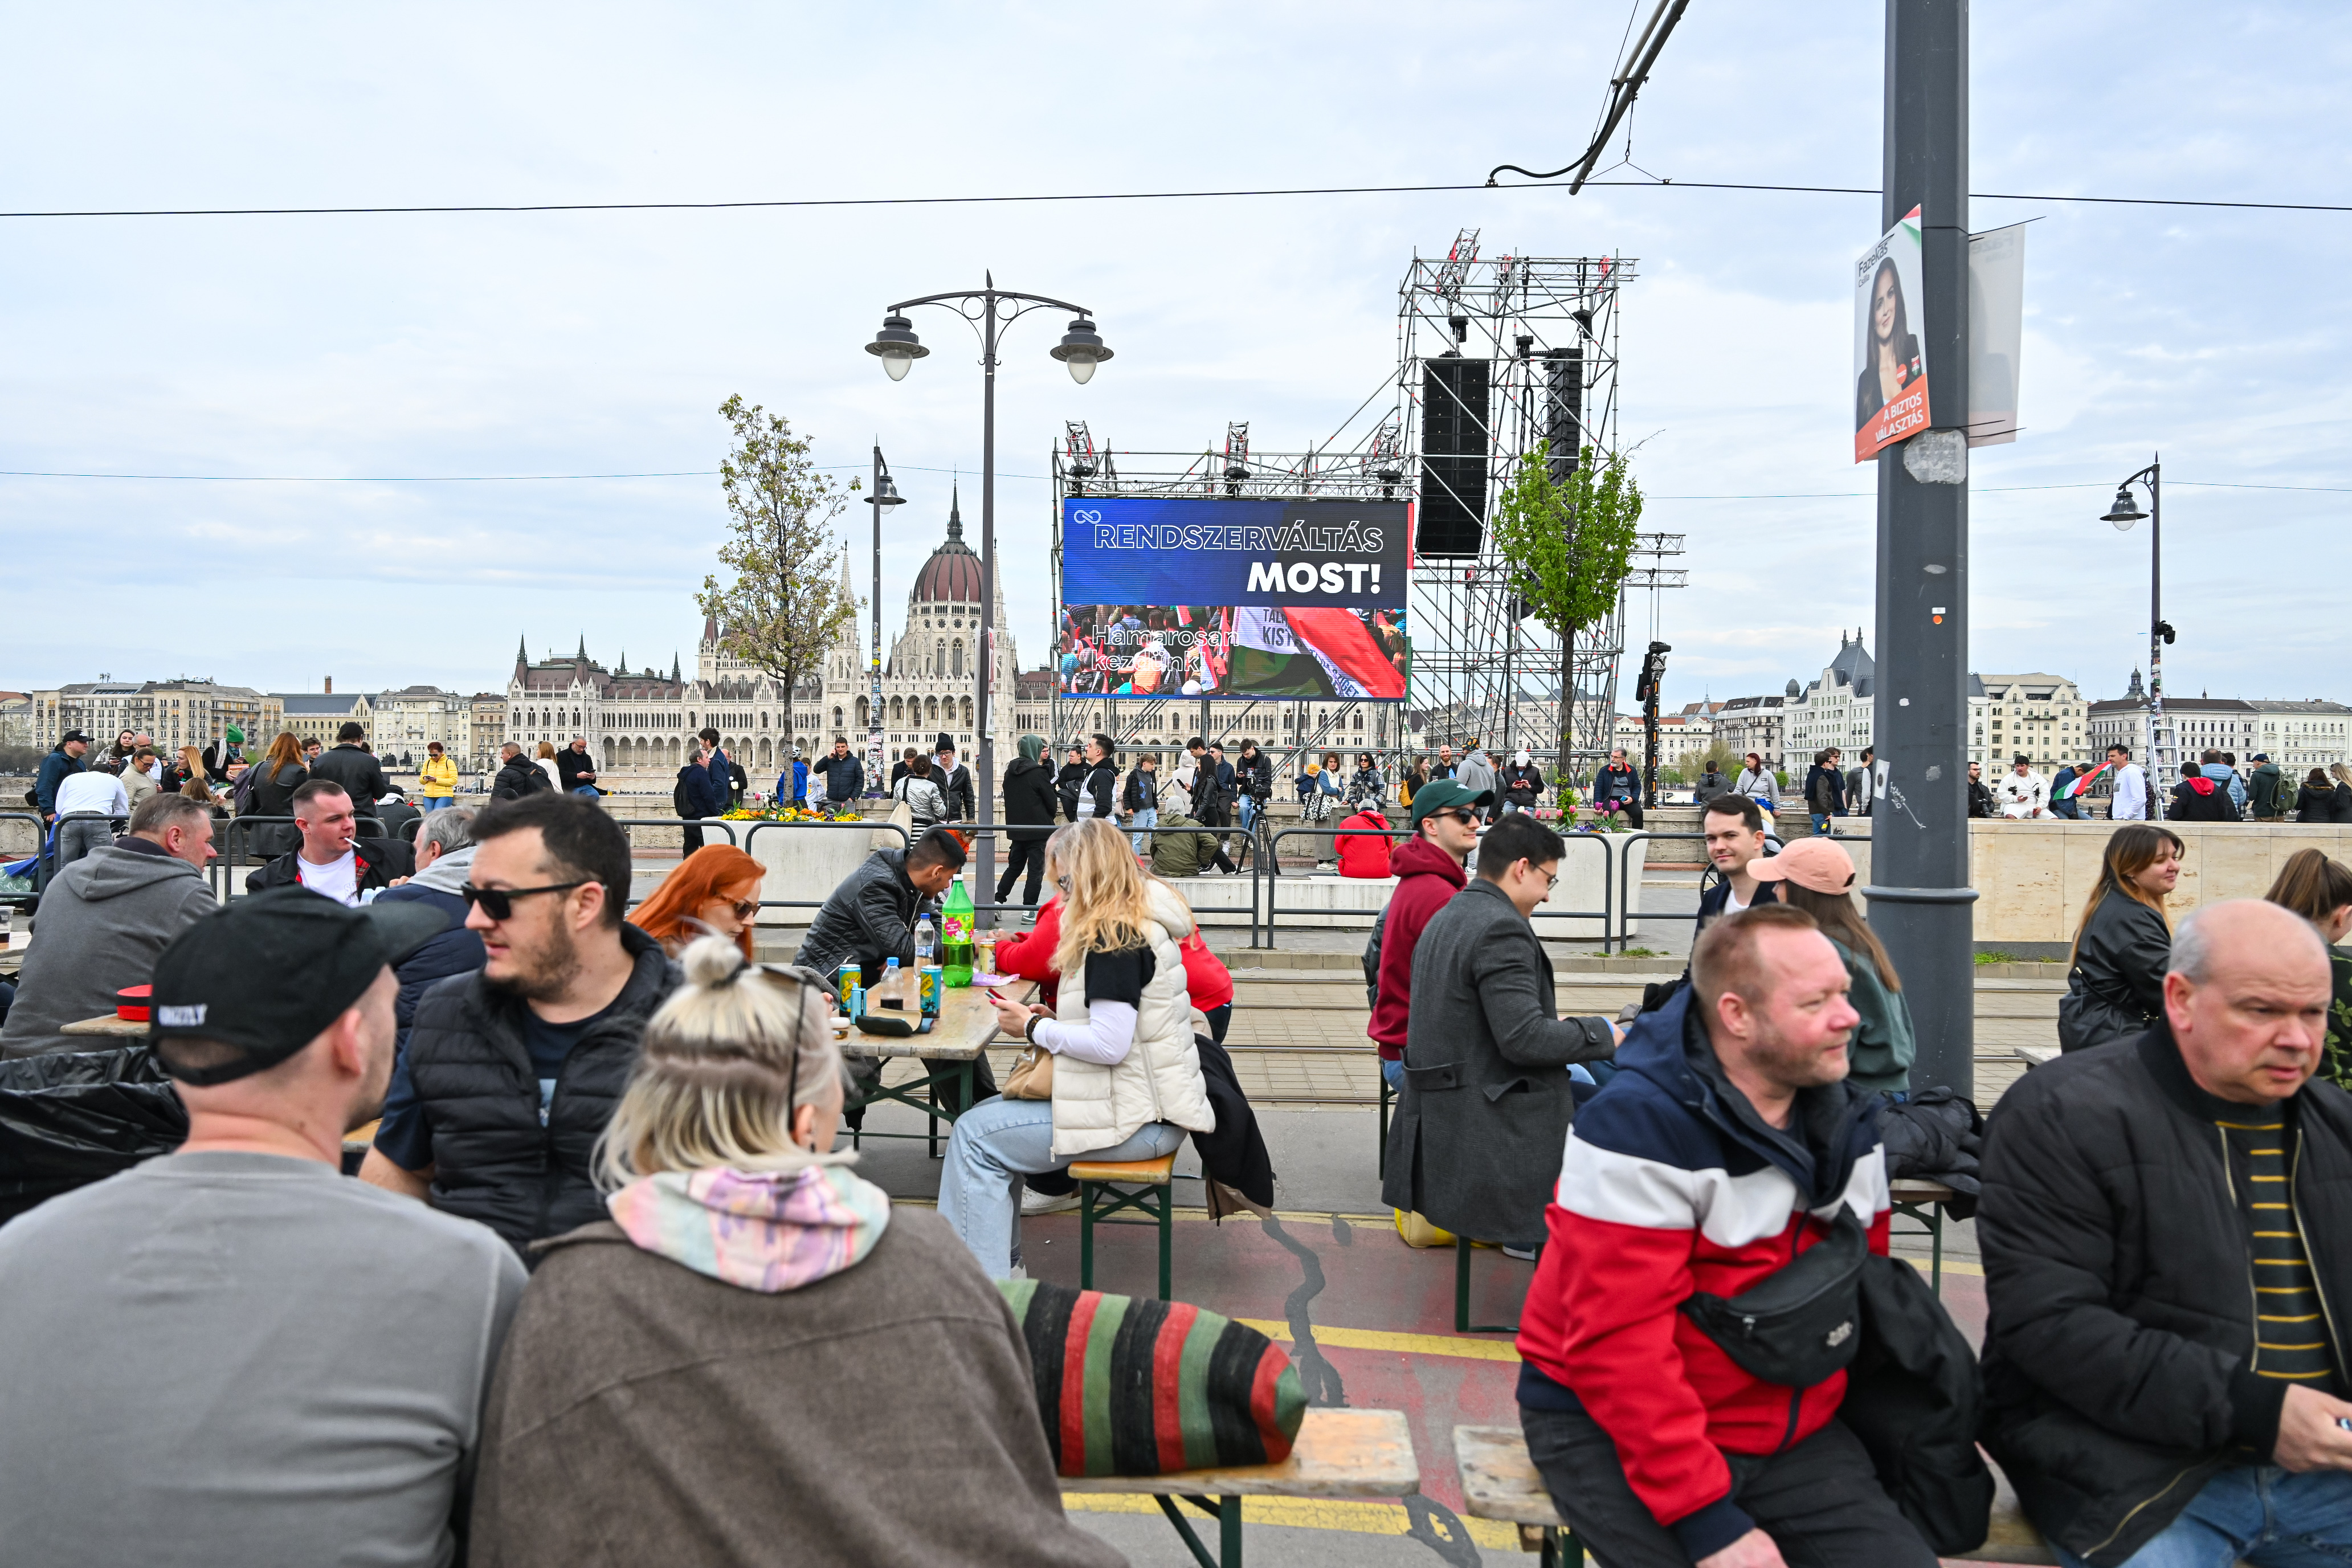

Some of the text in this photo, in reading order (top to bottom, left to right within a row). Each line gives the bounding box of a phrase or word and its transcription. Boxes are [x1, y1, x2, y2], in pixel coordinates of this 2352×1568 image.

[1859, 242, 1888, 277] Fazekas
[1859, 274, 1870, 288] Csilla
[1884, 392, 1922, 422] A BIZTOS
[1875, 409, 1924, 442] VÁLASZTÁS
[1094, 520, 1383, 553] RENDSZERVÁLTÁS
[1246, 562, 1381, 594] MOST!
[1092, 625, 1239, 647] Hamarosan
[1091, 650, 1206, 672] kezdünk!
